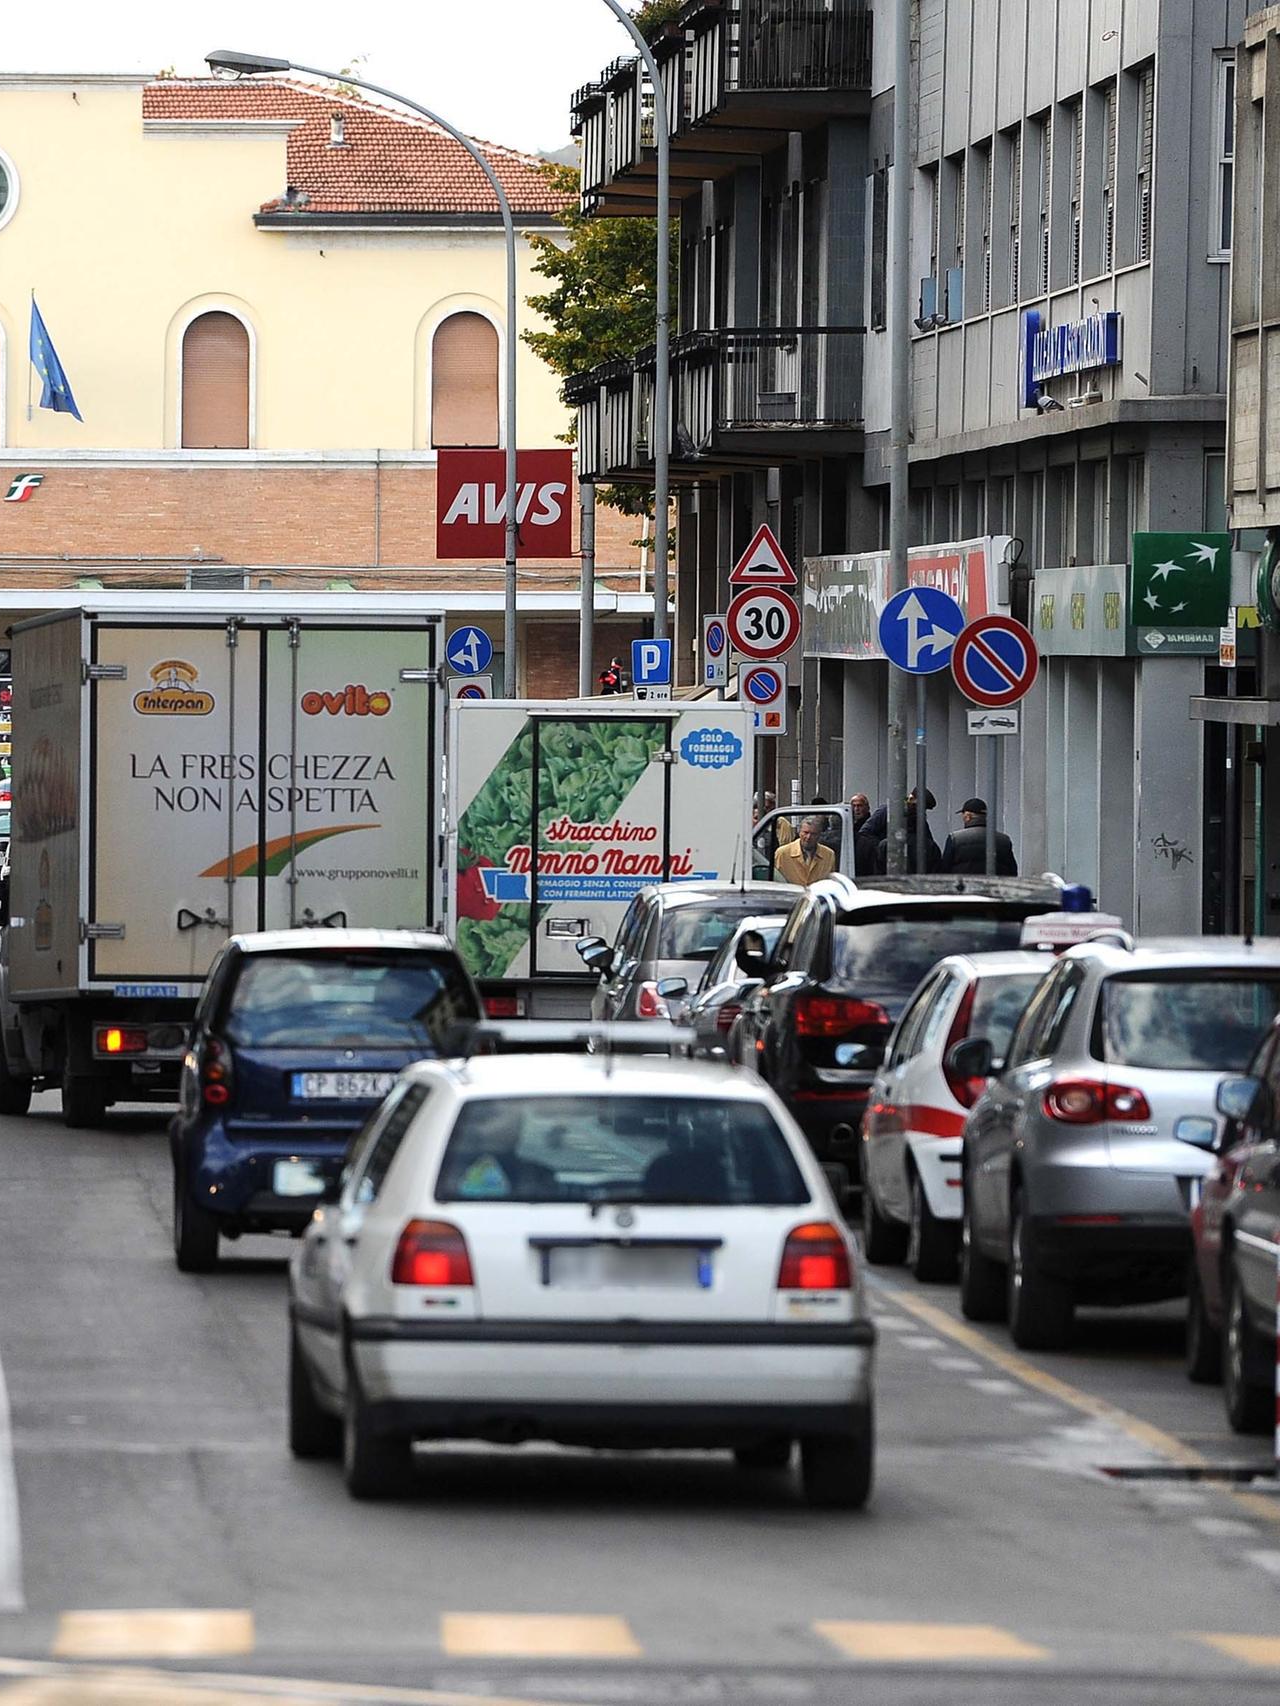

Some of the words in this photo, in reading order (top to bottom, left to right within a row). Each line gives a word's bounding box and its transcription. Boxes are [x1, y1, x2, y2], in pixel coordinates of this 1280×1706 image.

[442, 482, 567, 526] AVIS
[743, 606, 785, 641] 30
[640, 645, 661, 679] P
[143, 697, 204, 711] interpan
[301, 685, 391, 716] ovito
[688, 745, 735, 753] FORMAGGI
[700, 734, 723, 742] SOLO
[130, 754, 170, 779] LA
[693, 755, 729, 763] FRESCHI
[155, 787, 222, 812] NON
[236, 787, 379, 813] ASPETTA
[546, 816, 657, 842] stracchino
[507, 848, 601, 875] Nonno
[601, 847, 694, 876] Nanni
[296, 868, 419, 881] www.grupponovelli.it
[583, 880, 611, 888] SENZA
[543, 889, 563, 897] CON
[565, 889, 605, 897] FERMENTI
